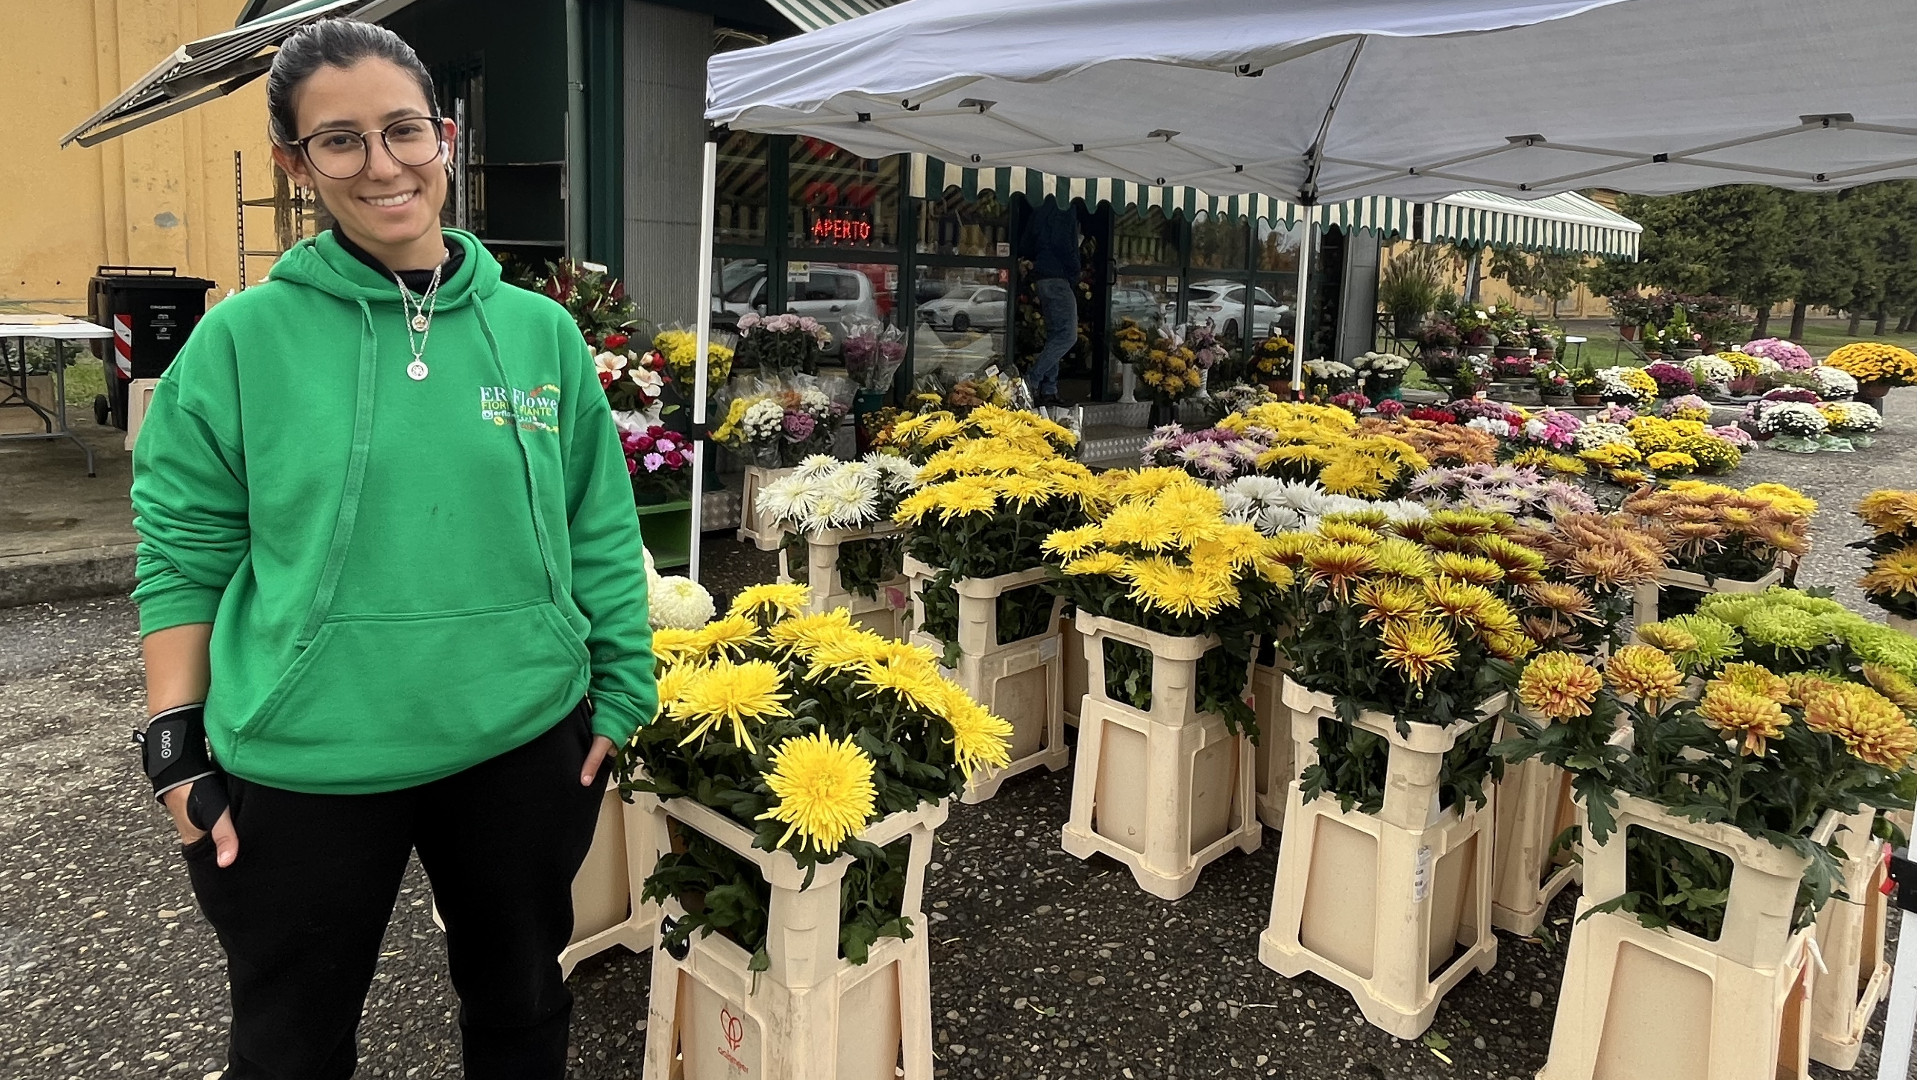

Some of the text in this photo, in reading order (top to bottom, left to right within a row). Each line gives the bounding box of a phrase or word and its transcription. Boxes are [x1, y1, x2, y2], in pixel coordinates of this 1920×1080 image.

[814, 218, 870, 239] APERTO
[480, 386, 508, 401] ER
[482, 402, 509, 411] FIORI
